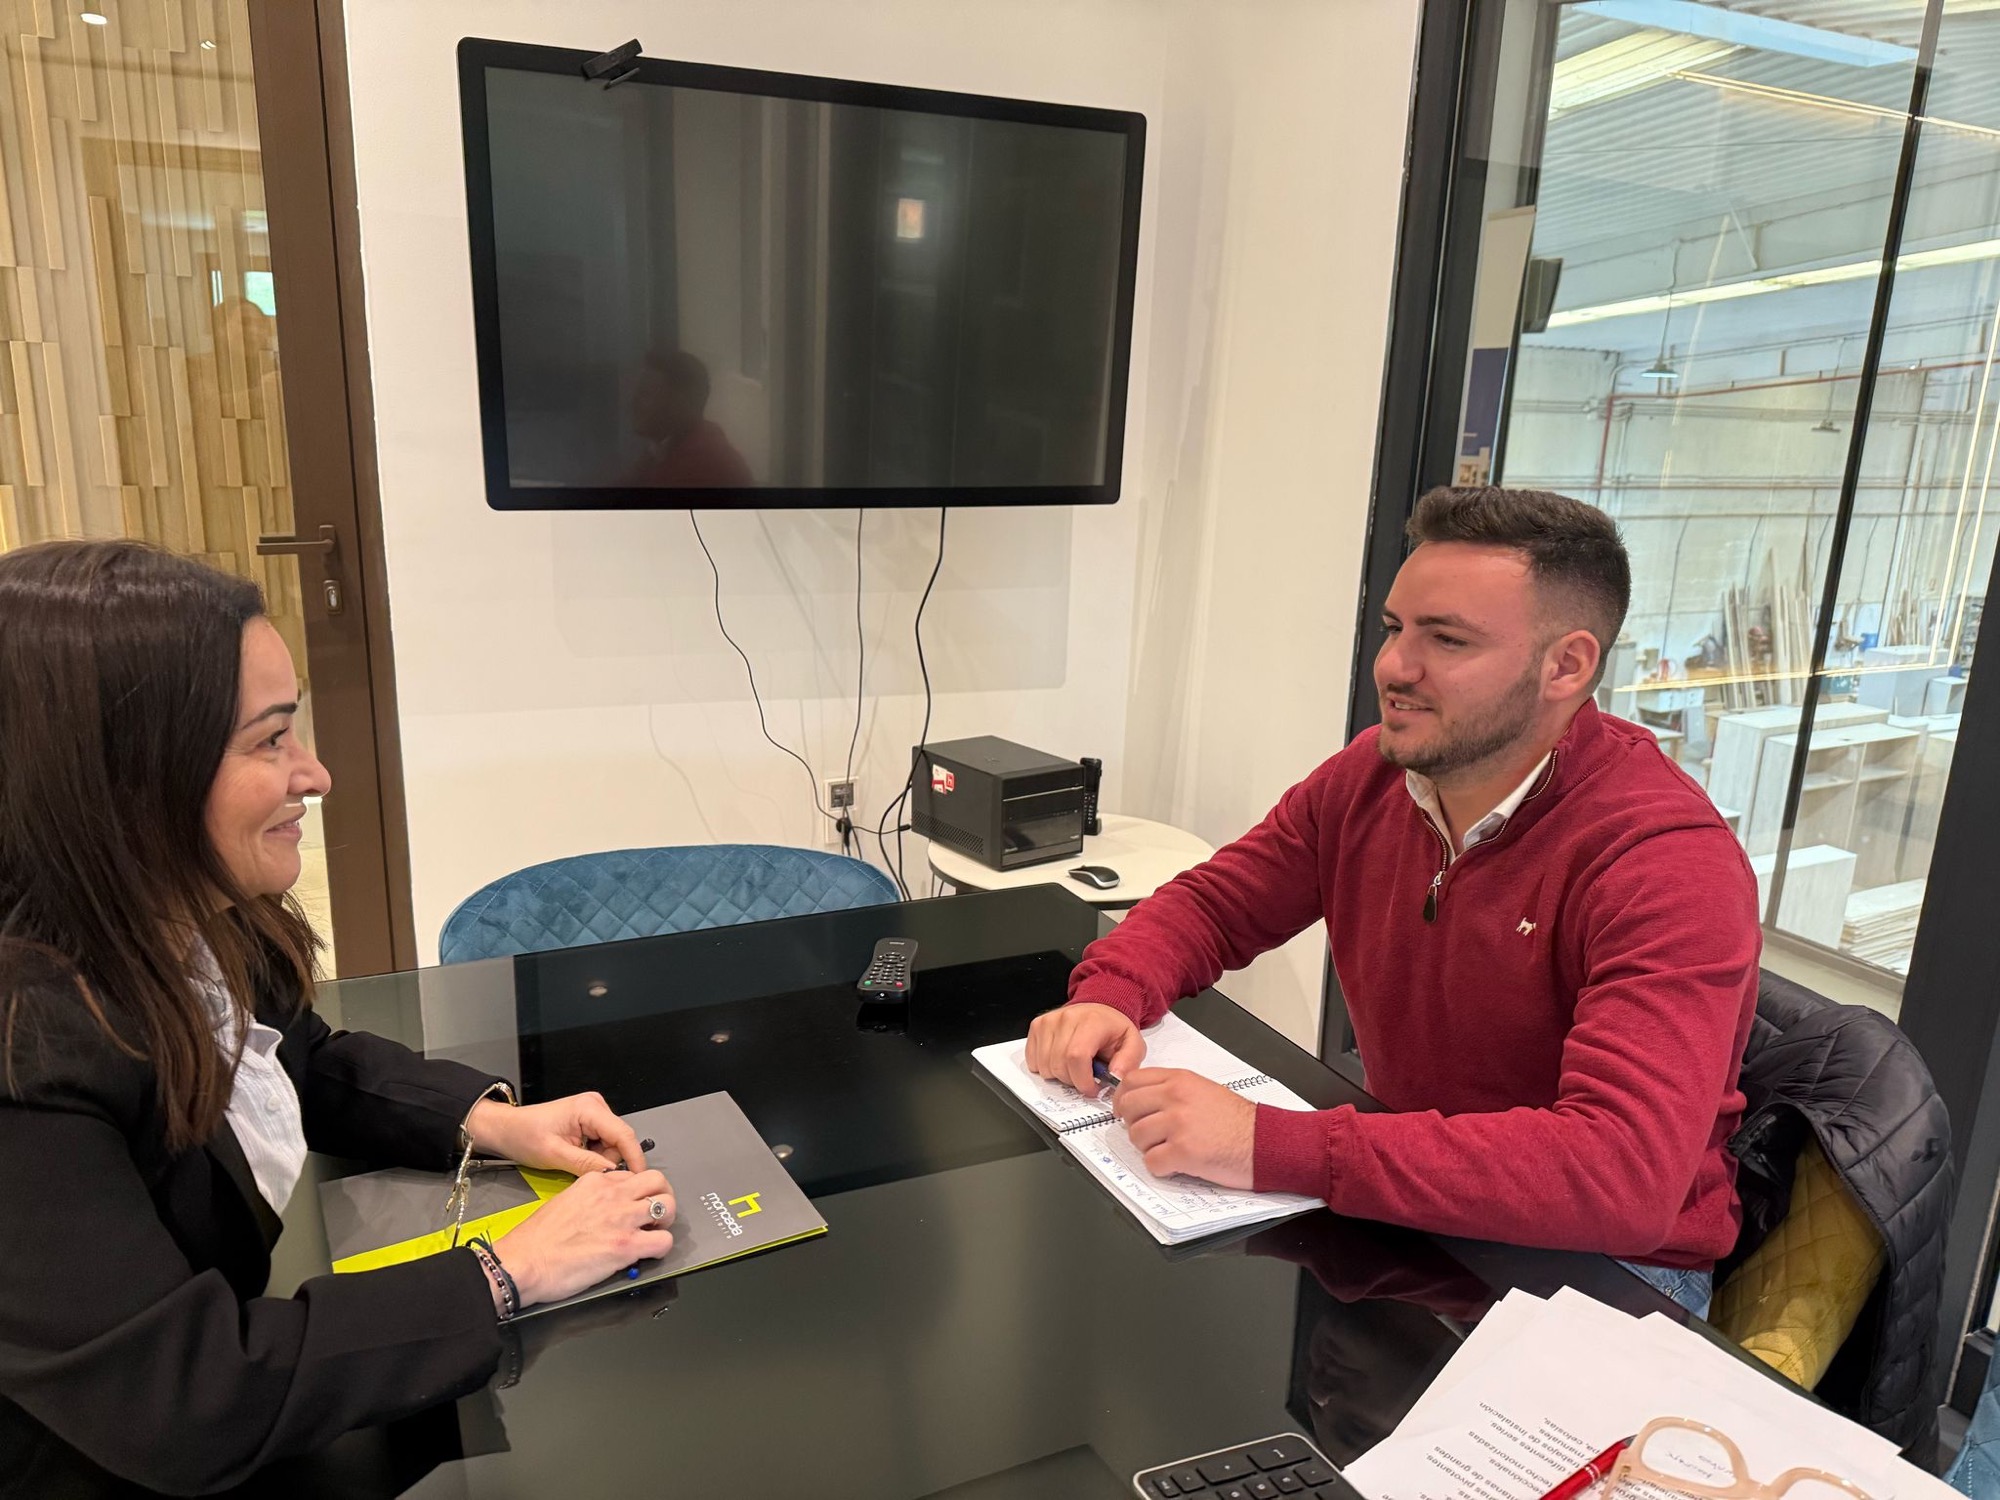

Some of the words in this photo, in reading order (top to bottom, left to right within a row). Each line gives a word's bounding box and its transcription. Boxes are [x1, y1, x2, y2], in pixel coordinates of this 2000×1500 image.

[707, 1192, 743, 1237] moncada
[1468, 1430, 1525, 1470] motorizadas
[1528, 1433, 1541, 1445] de
[1433, 1446, 1472, 1472] grandes
[1518, 1440, 1567, 1473] diferentes
[1541, 1441, 1580, 1470] trabajos
[1471, 1470, 1485, 1481] de
[1525, 1468, 1554, 1488] techo
